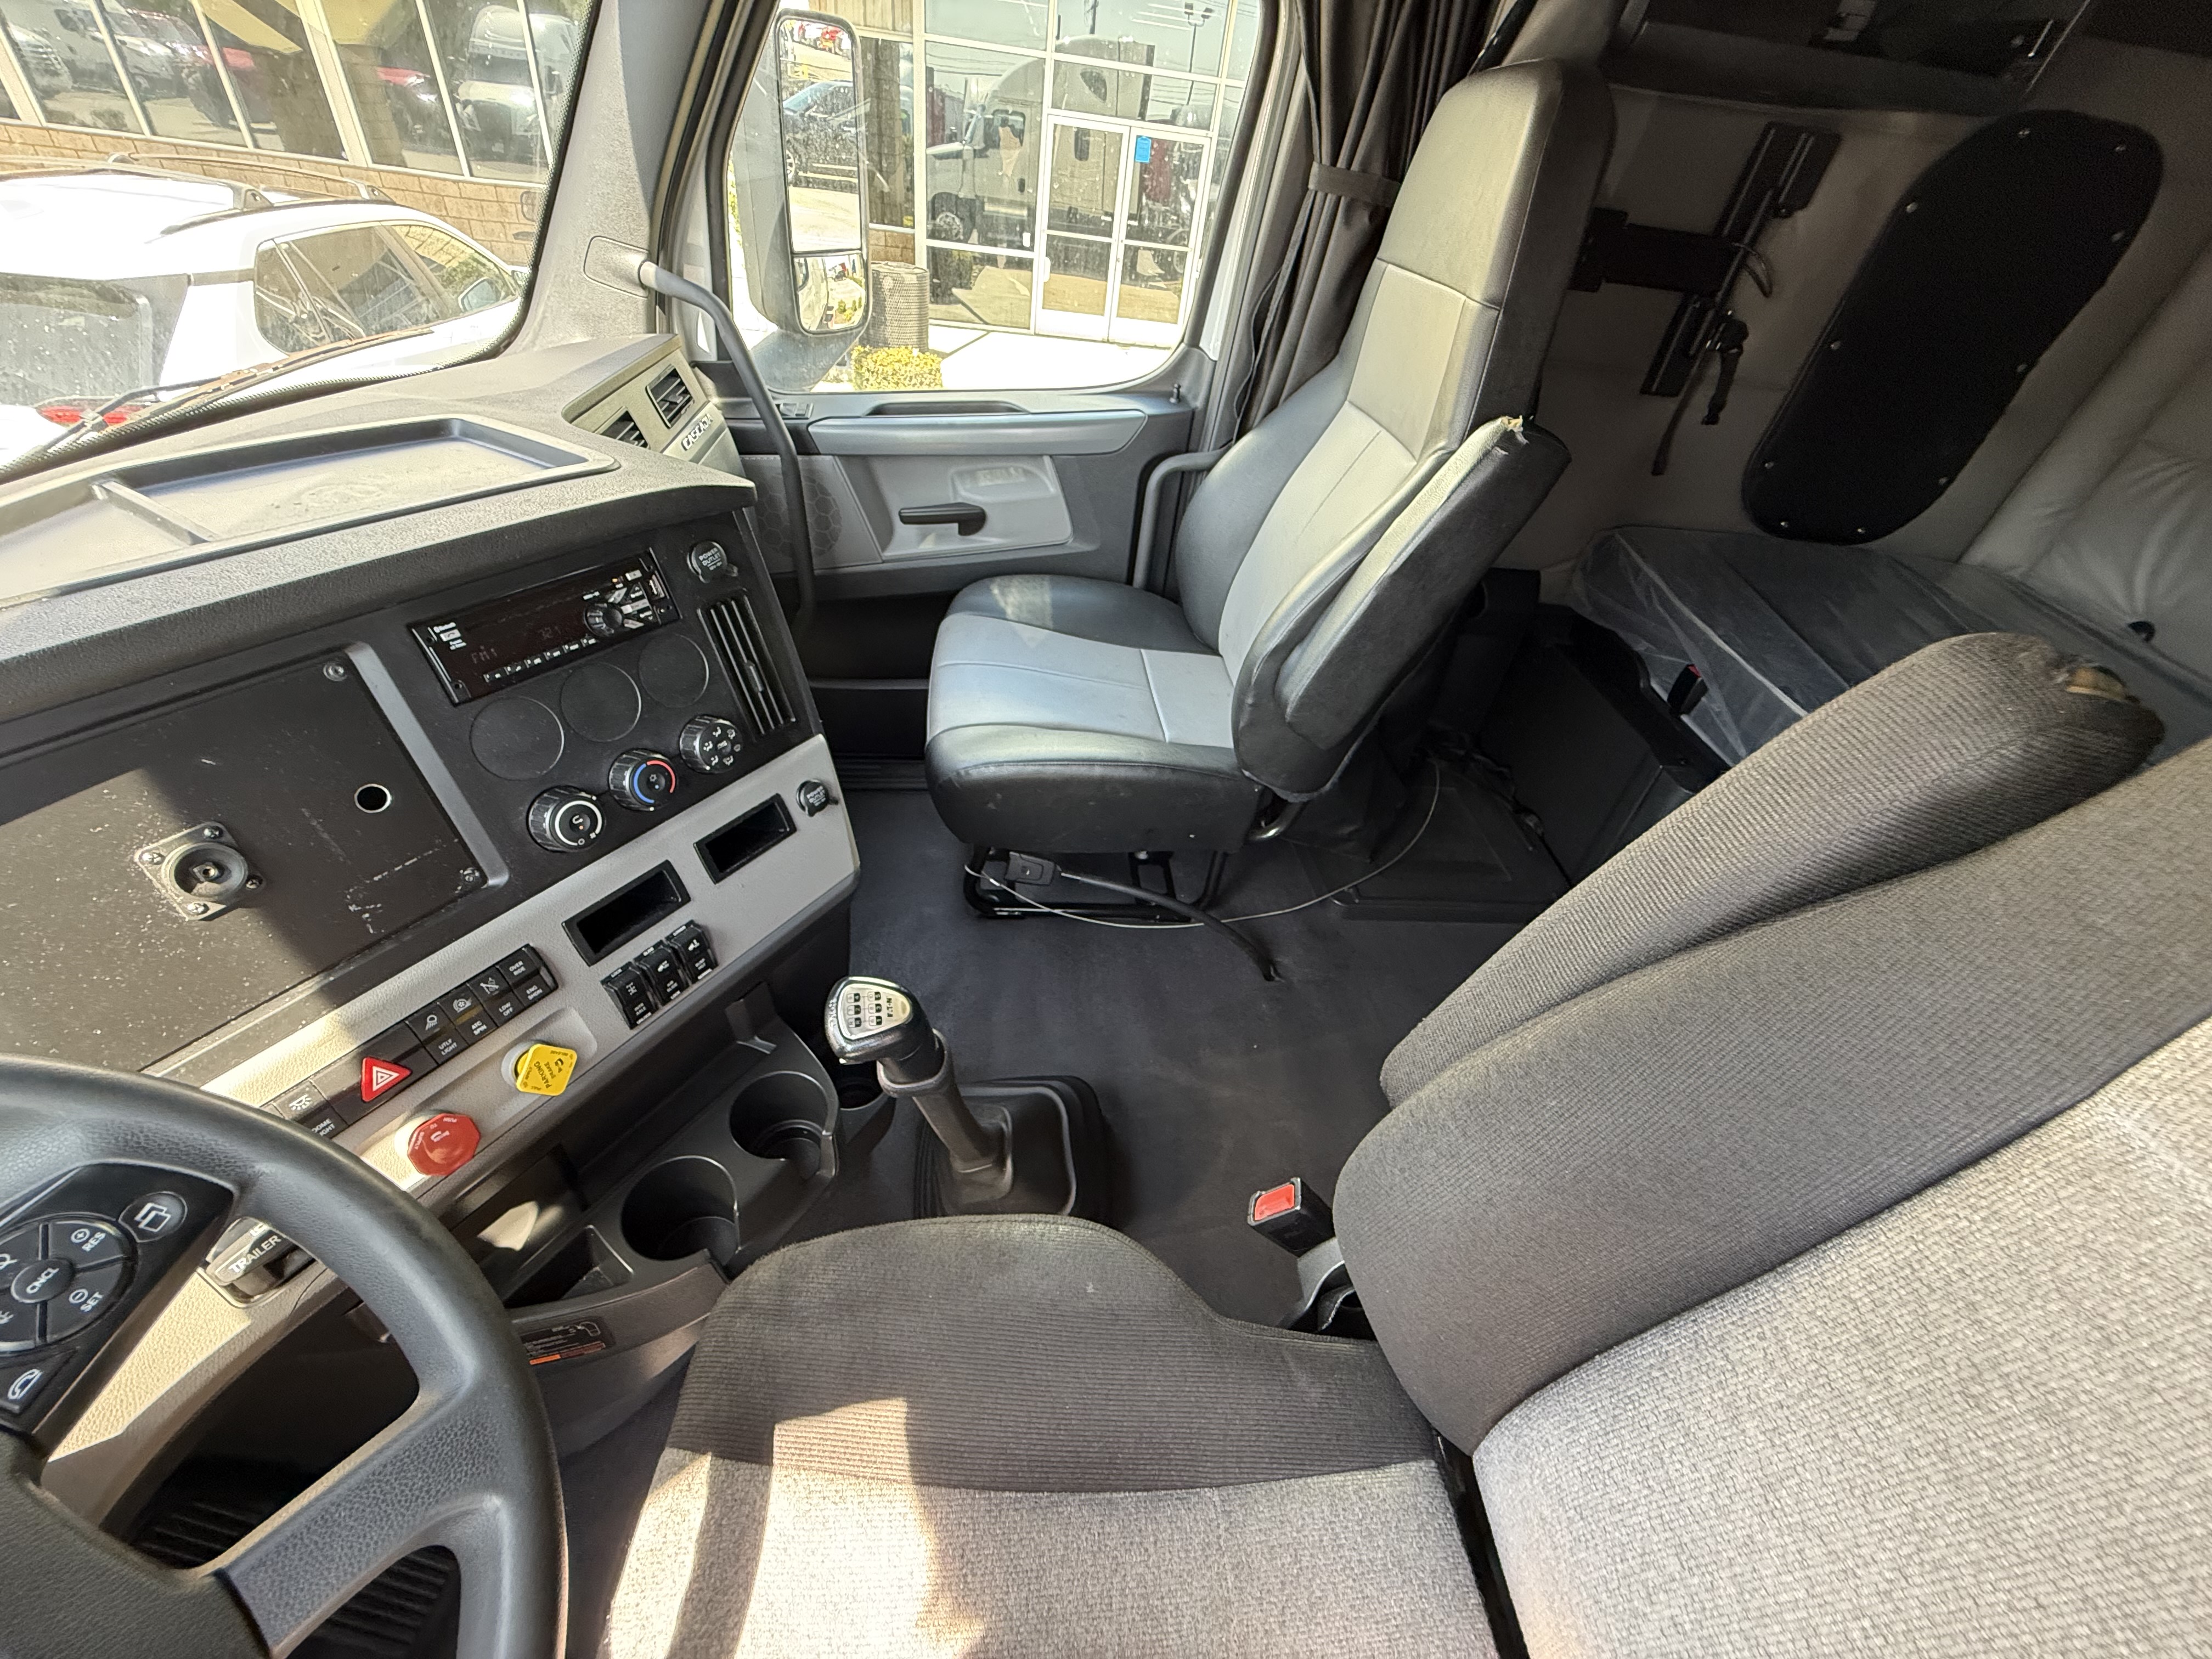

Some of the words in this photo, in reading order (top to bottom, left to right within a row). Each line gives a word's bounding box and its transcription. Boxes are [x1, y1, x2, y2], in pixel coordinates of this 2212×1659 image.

[698, 548, 718, 561] POWER
[702, 552, 721, 566] OUTLET
[806, 786, 823, 799] POWER
[509, 961, 524, 972] OVER
[513, 966, 526, 975] RIDE
[611, 968, 623, 978] LOCK
[526, 985, 538, 994] ENG
[503, 1007, 513, 1016] OFF
[471, 1020, 483, 1030] ATC
[473, 1024, 487, 1035] SPIN
[438, 1038, 452, 1050] UTLY
[441, 1042, 458, 1056] LIGHT
[534, 1061, 552, 1088] PARKING
[544, 1061, 556, 1079] BRAKE
[319, 1123, 335, 1136] IGHT
[82, 1232, 106, 1252] RES
[228, 1235, 281, 1273] TRAILER
[26, 1268, 59, 1294] CNCL
[80, 1291, 104, 1312] SET
